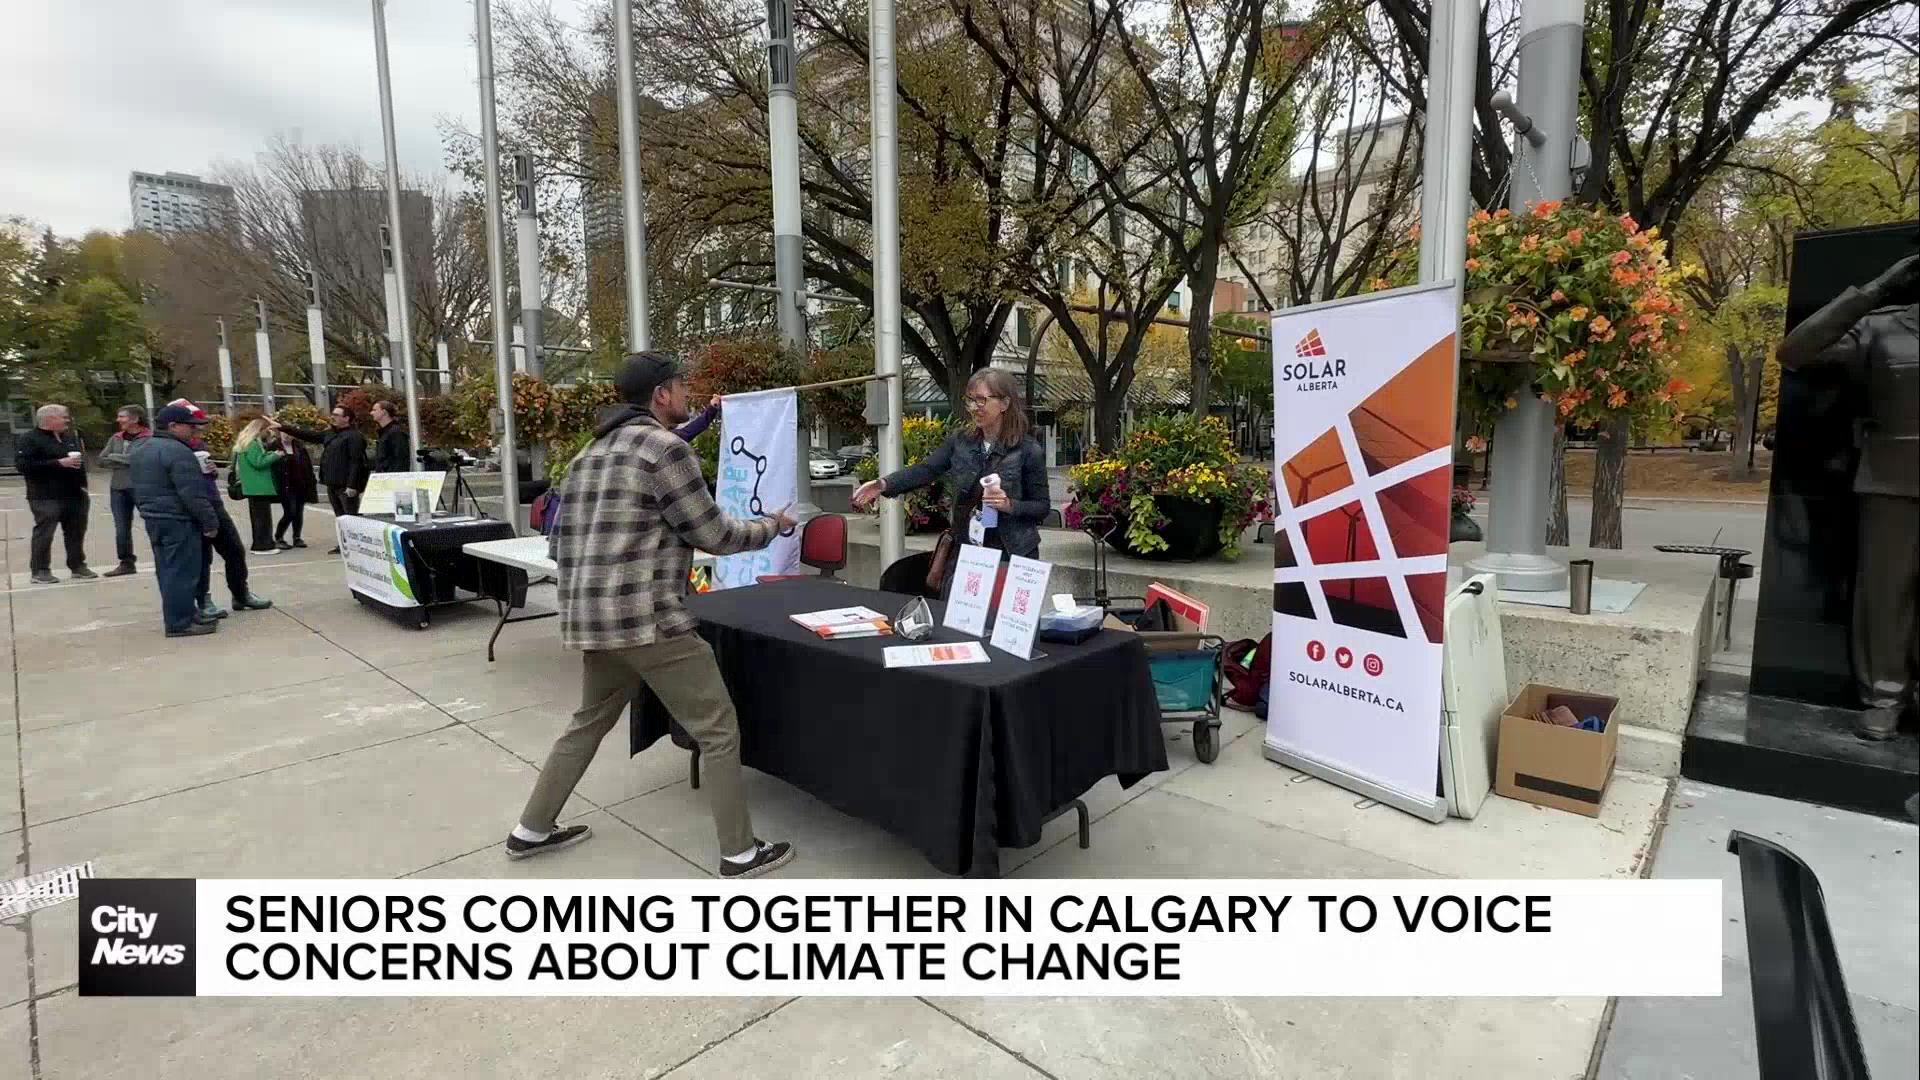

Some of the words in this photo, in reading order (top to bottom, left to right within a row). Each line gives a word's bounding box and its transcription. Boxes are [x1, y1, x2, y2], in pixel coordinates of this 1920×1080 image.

[1283, 359, 1346, 381] SOLAR
[1297, 381, 1338, 391] ALBERTA
[1289, 671, 1405, 712] SOLARALBERTA.CA
